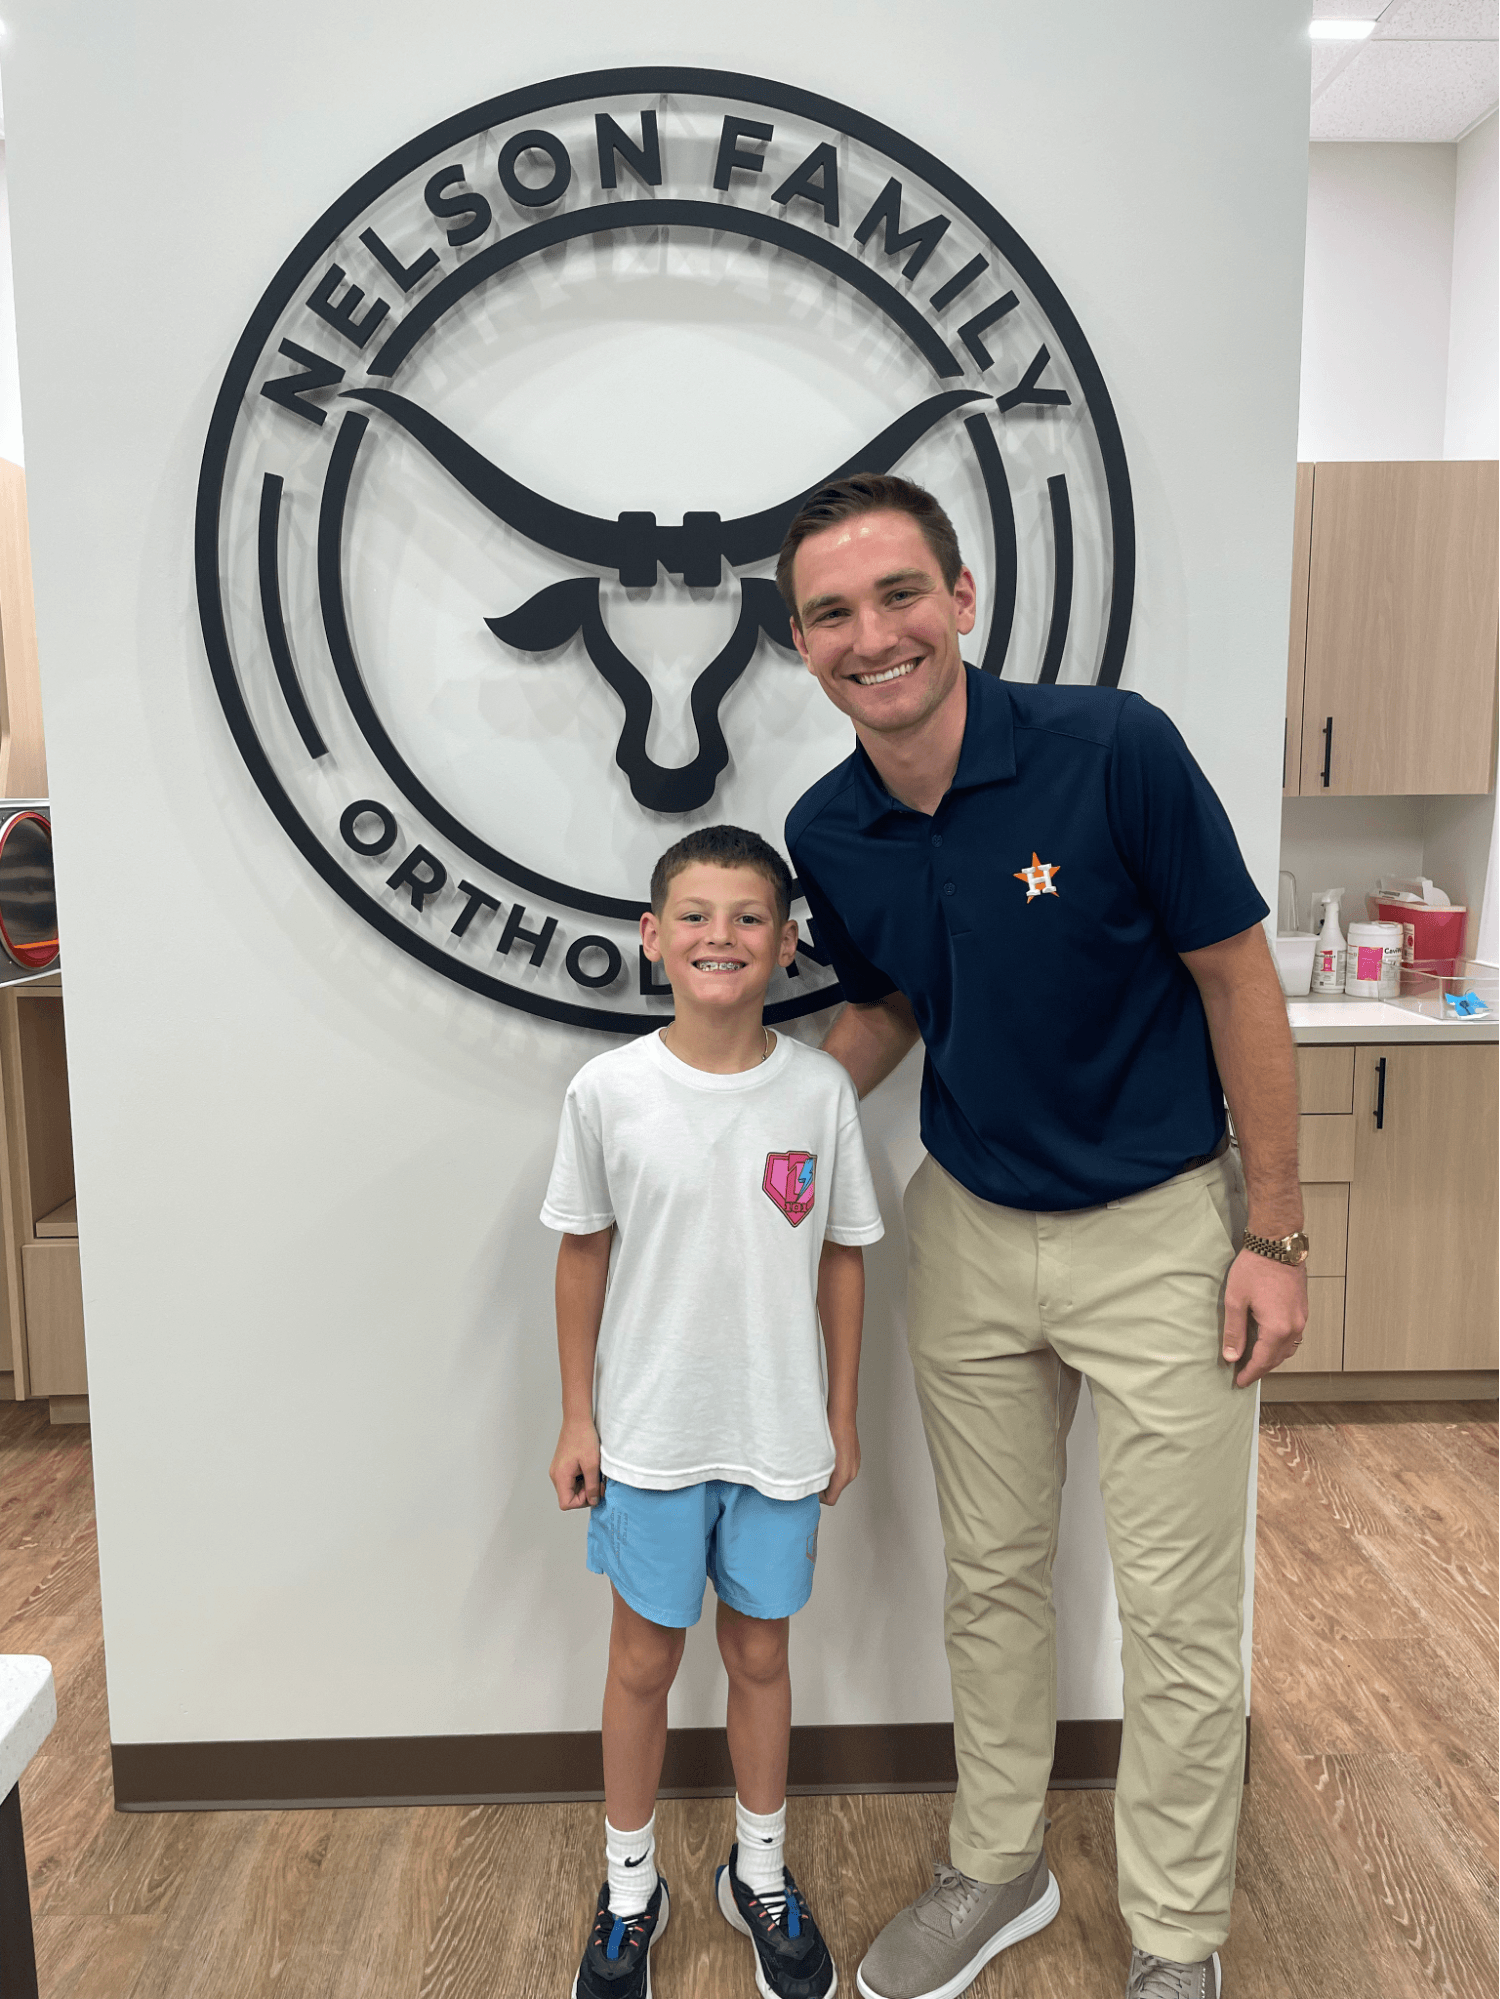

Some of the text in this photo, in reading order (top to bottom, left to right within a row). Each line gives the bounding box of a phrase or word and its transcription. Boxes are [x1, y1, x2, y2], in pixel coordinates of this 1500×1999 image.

[260, 109, 1072, 427] NELSON FAMILY
[1021, 863, 1057, 897] H
